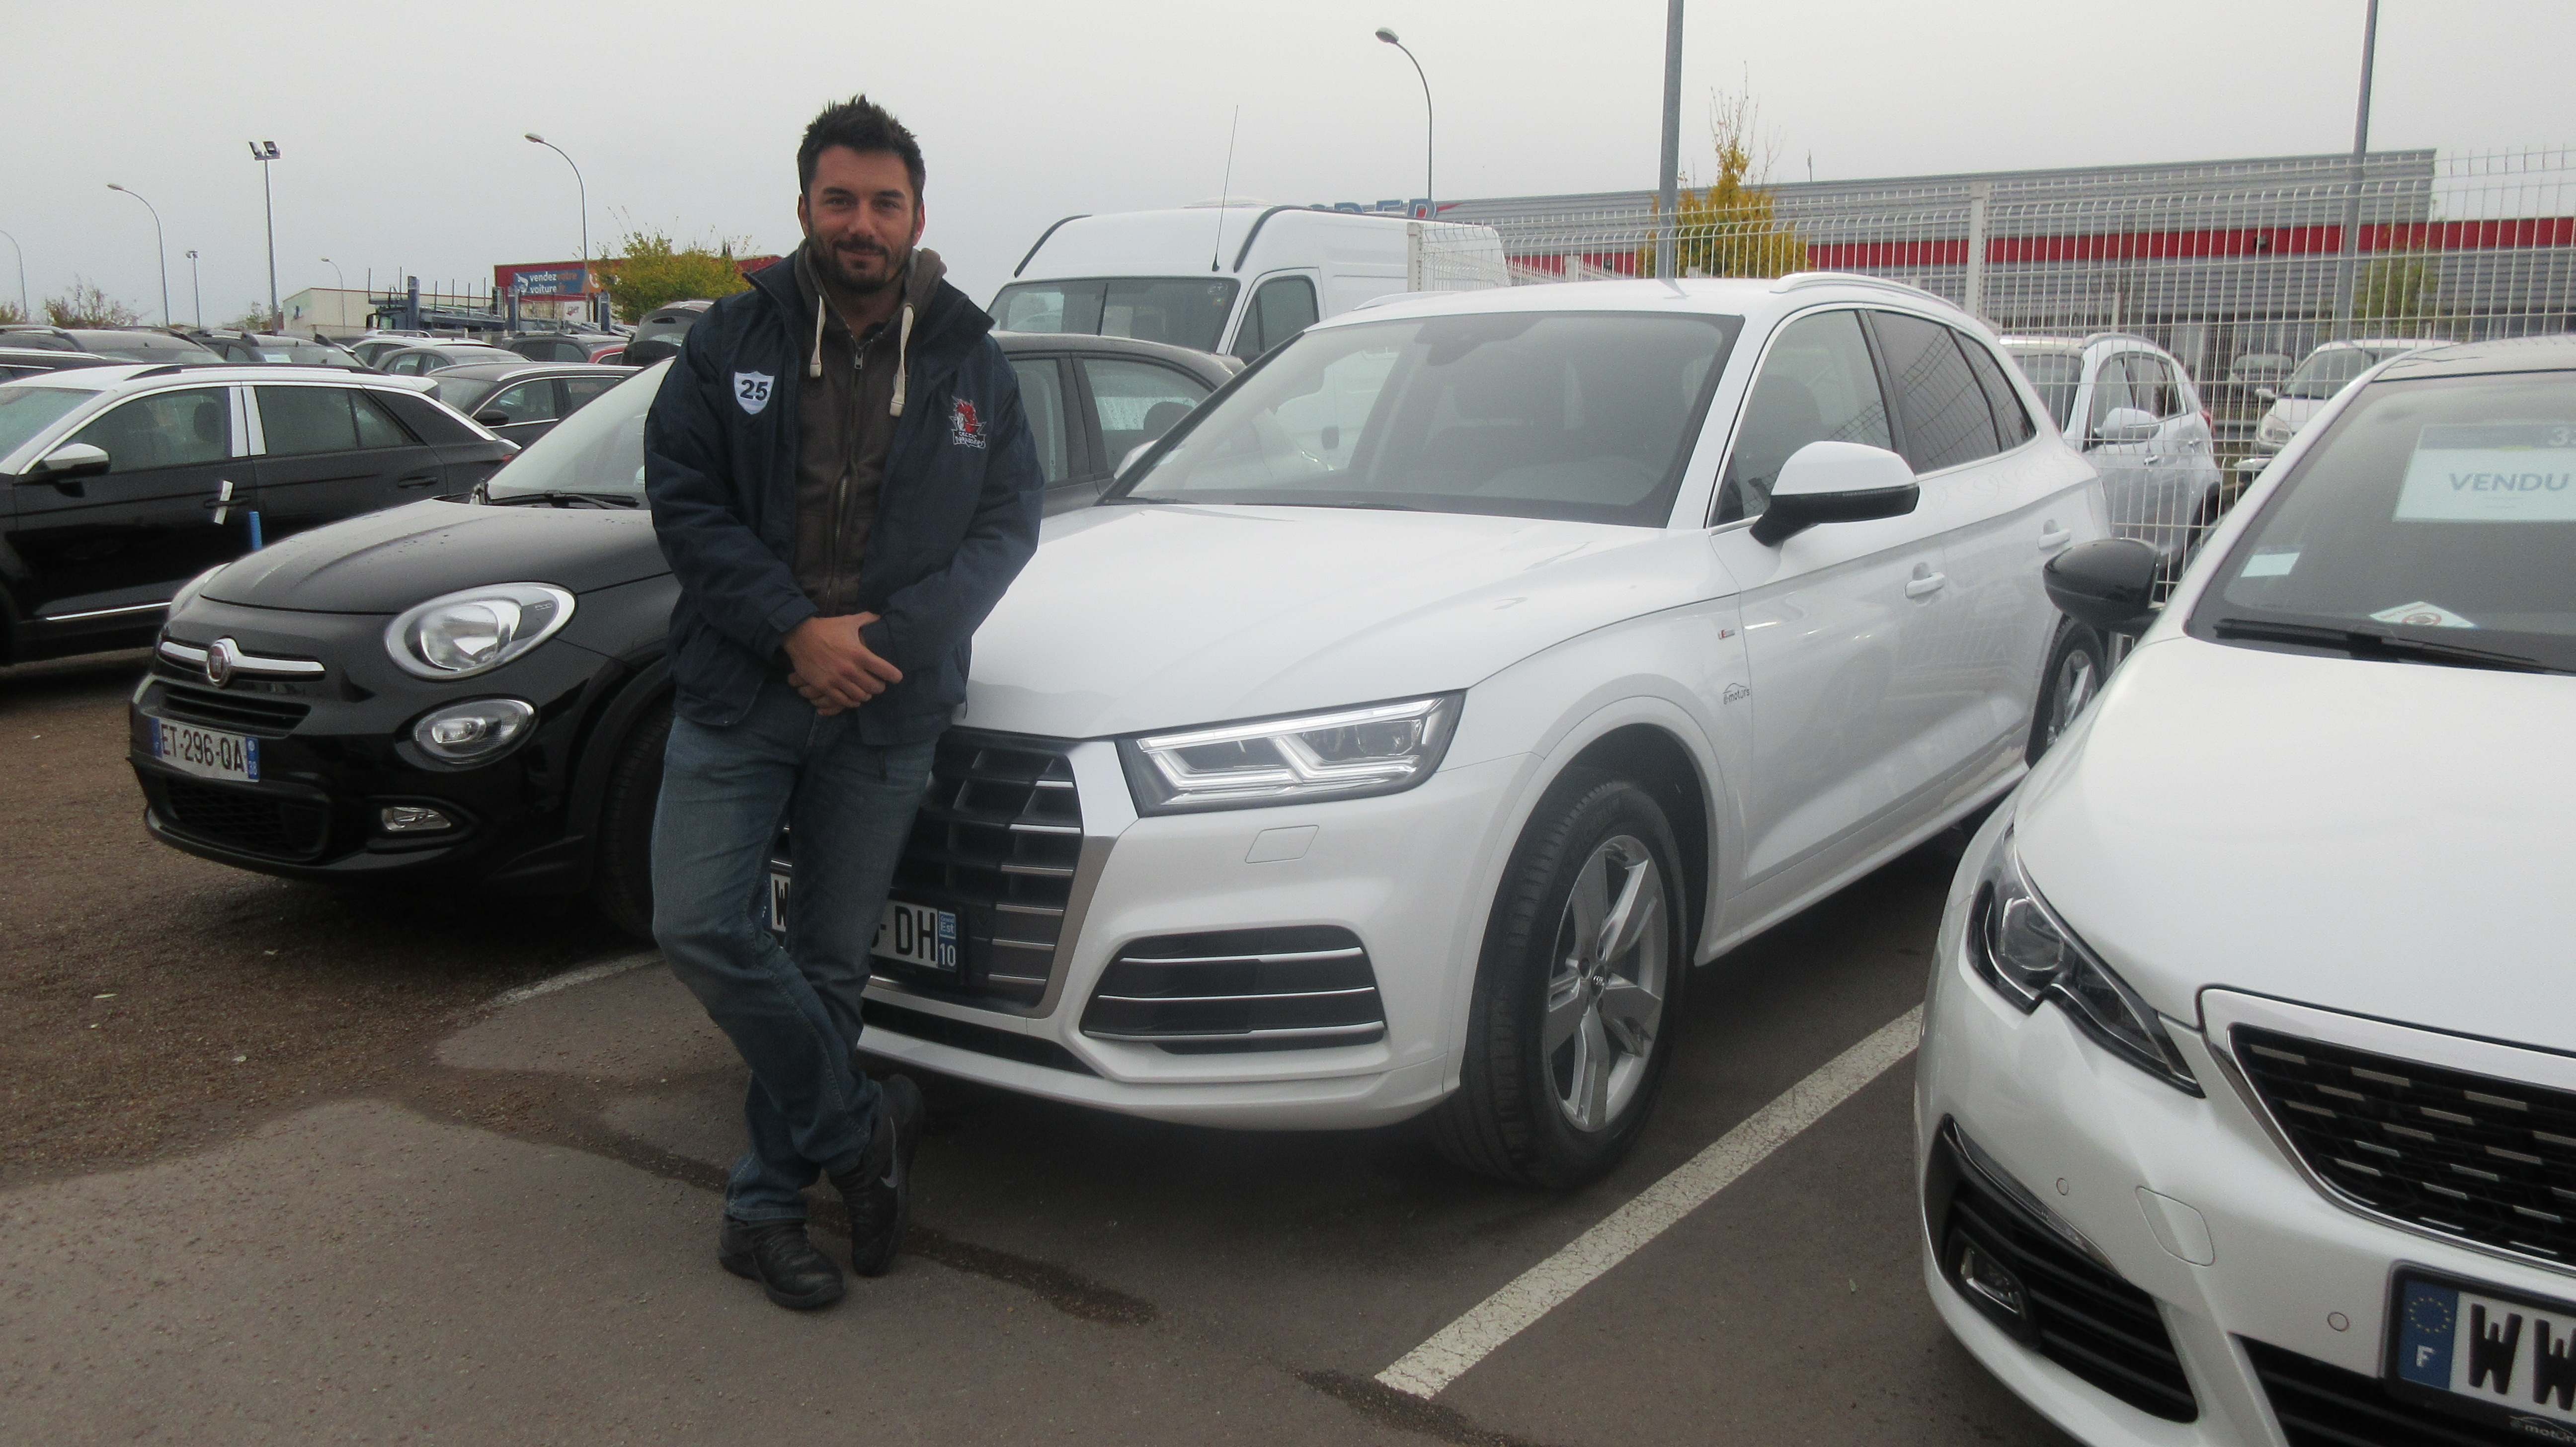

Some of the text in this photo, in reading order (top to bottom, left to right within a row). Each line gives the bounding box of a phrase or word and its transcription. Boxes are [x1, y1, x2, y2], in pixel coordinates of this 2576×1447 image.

[530, 271, 557, 282] vendez
[530, 284, 557, 294] voiture
[740, 380, 768, 401] 25
[2448, 473, 2570, 491] VENDU
[161, 724, 245, 773] ET-296-QA
[941, 922, 955, 934] Est
[939, 943, 956, 967] 10
[2416, 1345, 2436, 1368] F
